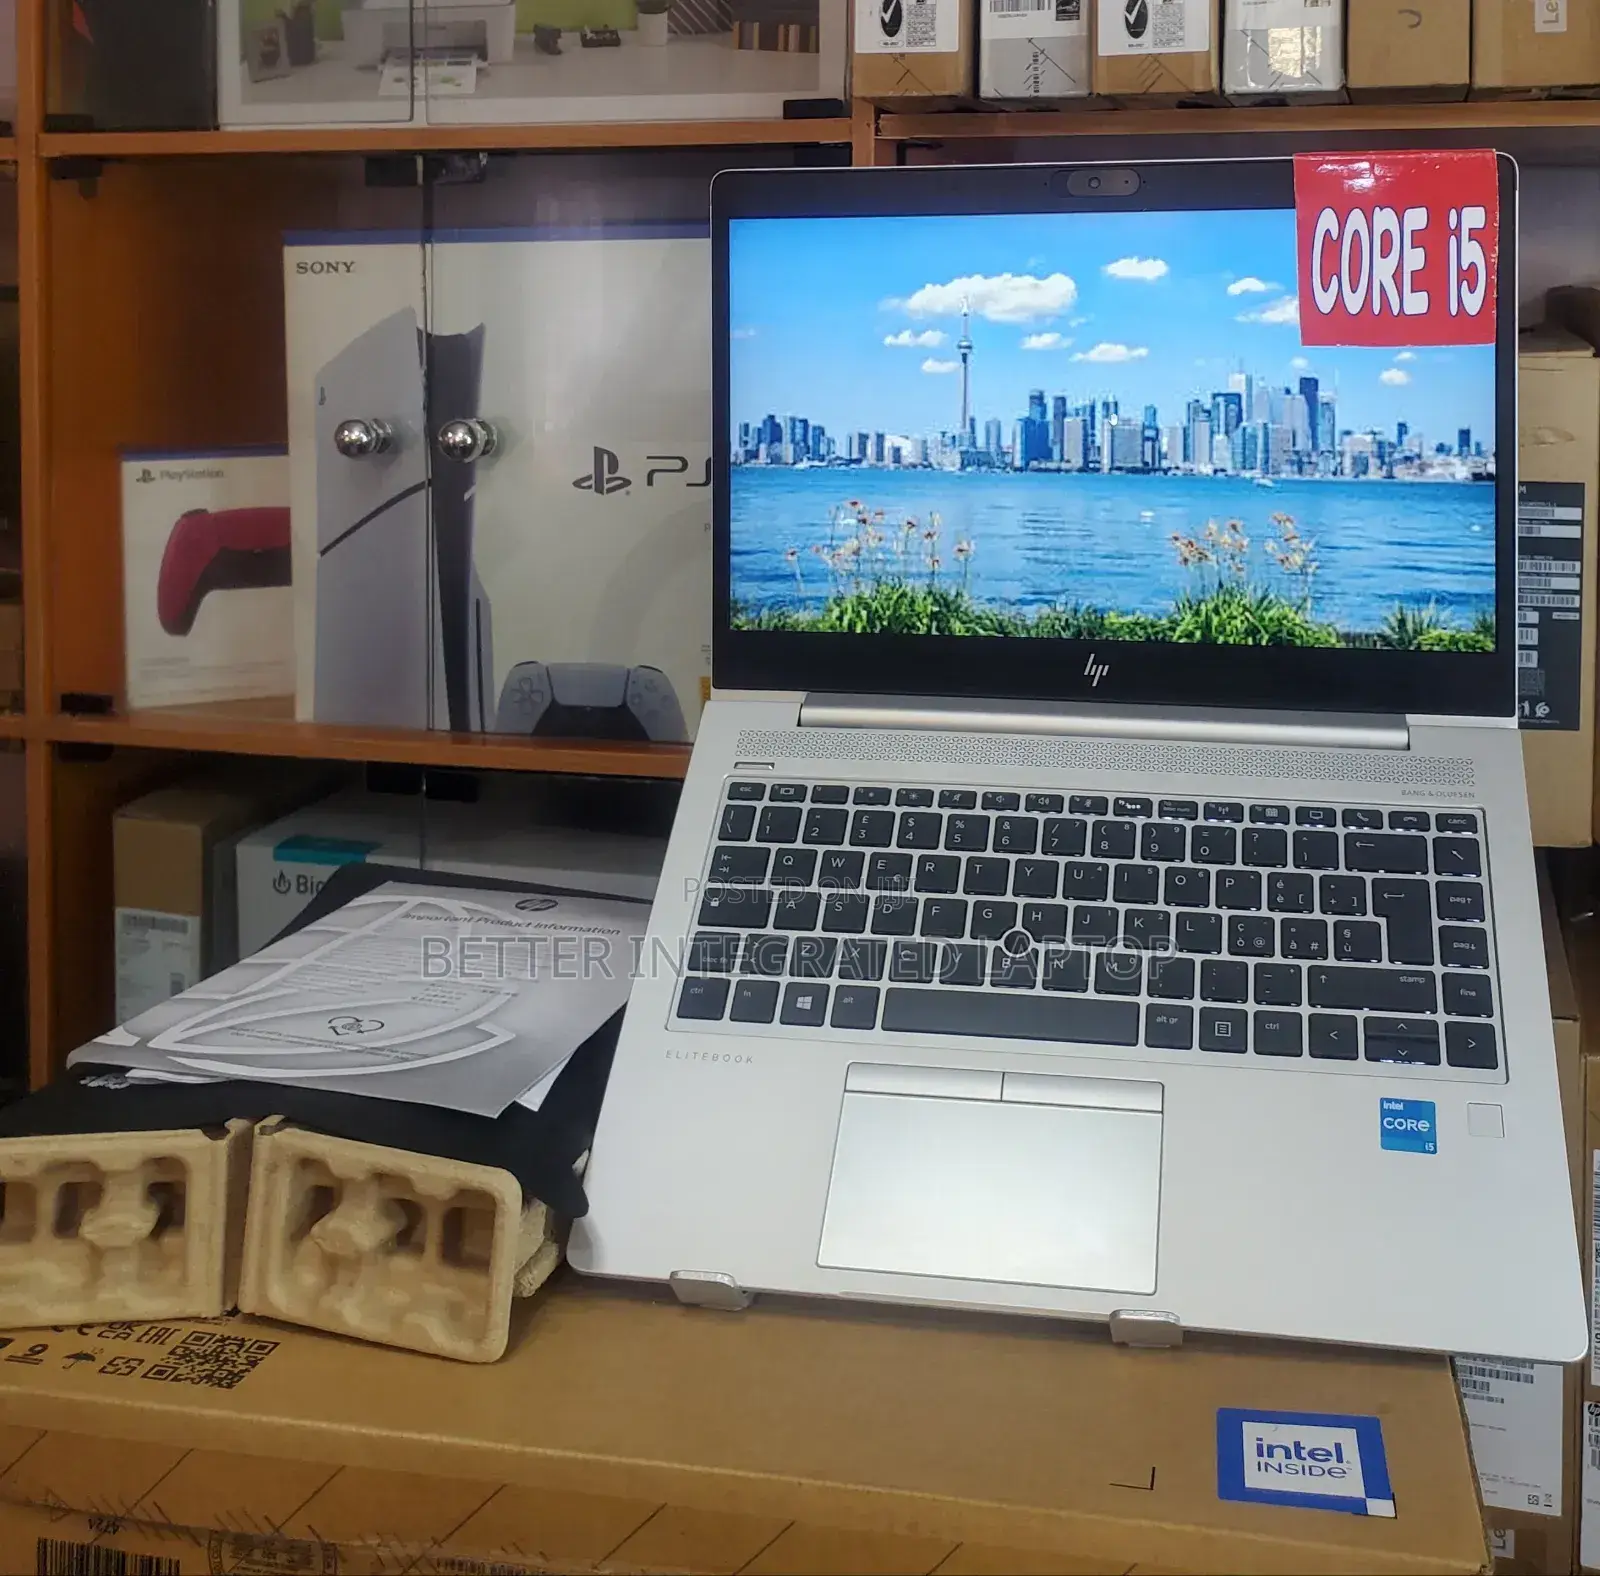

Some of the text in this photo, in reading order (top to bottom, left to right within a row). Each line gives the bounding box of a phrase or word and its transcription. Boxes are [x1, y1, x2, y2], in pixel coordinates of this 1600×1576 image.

[1311, 205, 1488, 318] CORE i5
[296, 261, 356, 275] SONY
[1401, 789, 1426, 797] BANG
[862, 815, 869, 824] £
[907, 817, 915, 827] $
[955, 820, 965, 829] %
[765, 825, 770, 834] 1
[1002, 821, 1011, 830] &
[1173, 826, 1180, 834] 9
[810, 827, 819, 837] 2
[858, 829, 867, 839] 3
[905, 831, 914, 841] 4
[953, 833, 962, 843] 5
[1001, 836, 1010, 845] 6
[1051, 838, 1059, 847] 7
[1100, 840, 1109, 850] 8
[1150, 843, 1159, 853] 9
[782, 855, 794, 866] Q
[830, 857, 846, 868] W
[876, 859, 887, 870] E
[925, 862, 936, 872] R
[973, 864, 983, 875] T
[1024, 866, 1035, 877] Y
[1073, 869, 1084, 880] U
[1124, 872, 1128, 882] I
[1174, 875, 1186, 886] O
[1225, 877, 1236, 888] P
[786, 900, 797, 910] A
[834, 901, 843, 912] S
[882, 903, 893, 914] D
[931, 905, 941, 916] F
[982, 908, 993, 919] G
[1031, 910, 1043, 922] H
[401, 912, 621, 937] Important Product Information
[1082, 914, 1091, 925] J
[1134, 913, 1164, 929] K 2
[1186, 920, 1195, 931] L
[1253, 936, 1266, 948] @
[1310, 941, 1320, 951] #
[800, 944, 811, 956] Z
[852, 947, 861, 958] X
[952, 952, 963, 964] V
[1002, 957, 1011, 968] B
[1053, 958, 1064, 970] N
[1106, 961, 1118, 973] M
[1399, 974, 1426, 984] stamp
[690, 986, 704, 995] ctrl
[743, 989, 752, 998] fn
[1459, 988, 1477, 997] fine
[1156, 1015, 1179, 1025] alt gr
[1265, 1021, 1280, 1031] ctrl
[665, 1049, 753, 1064] ELITEBOOK
[1383, 1100, 1404, 1111] intel
[1424, 1141, 1435, 1151] i5
[1255, 1437, 1345, 1464] intel
